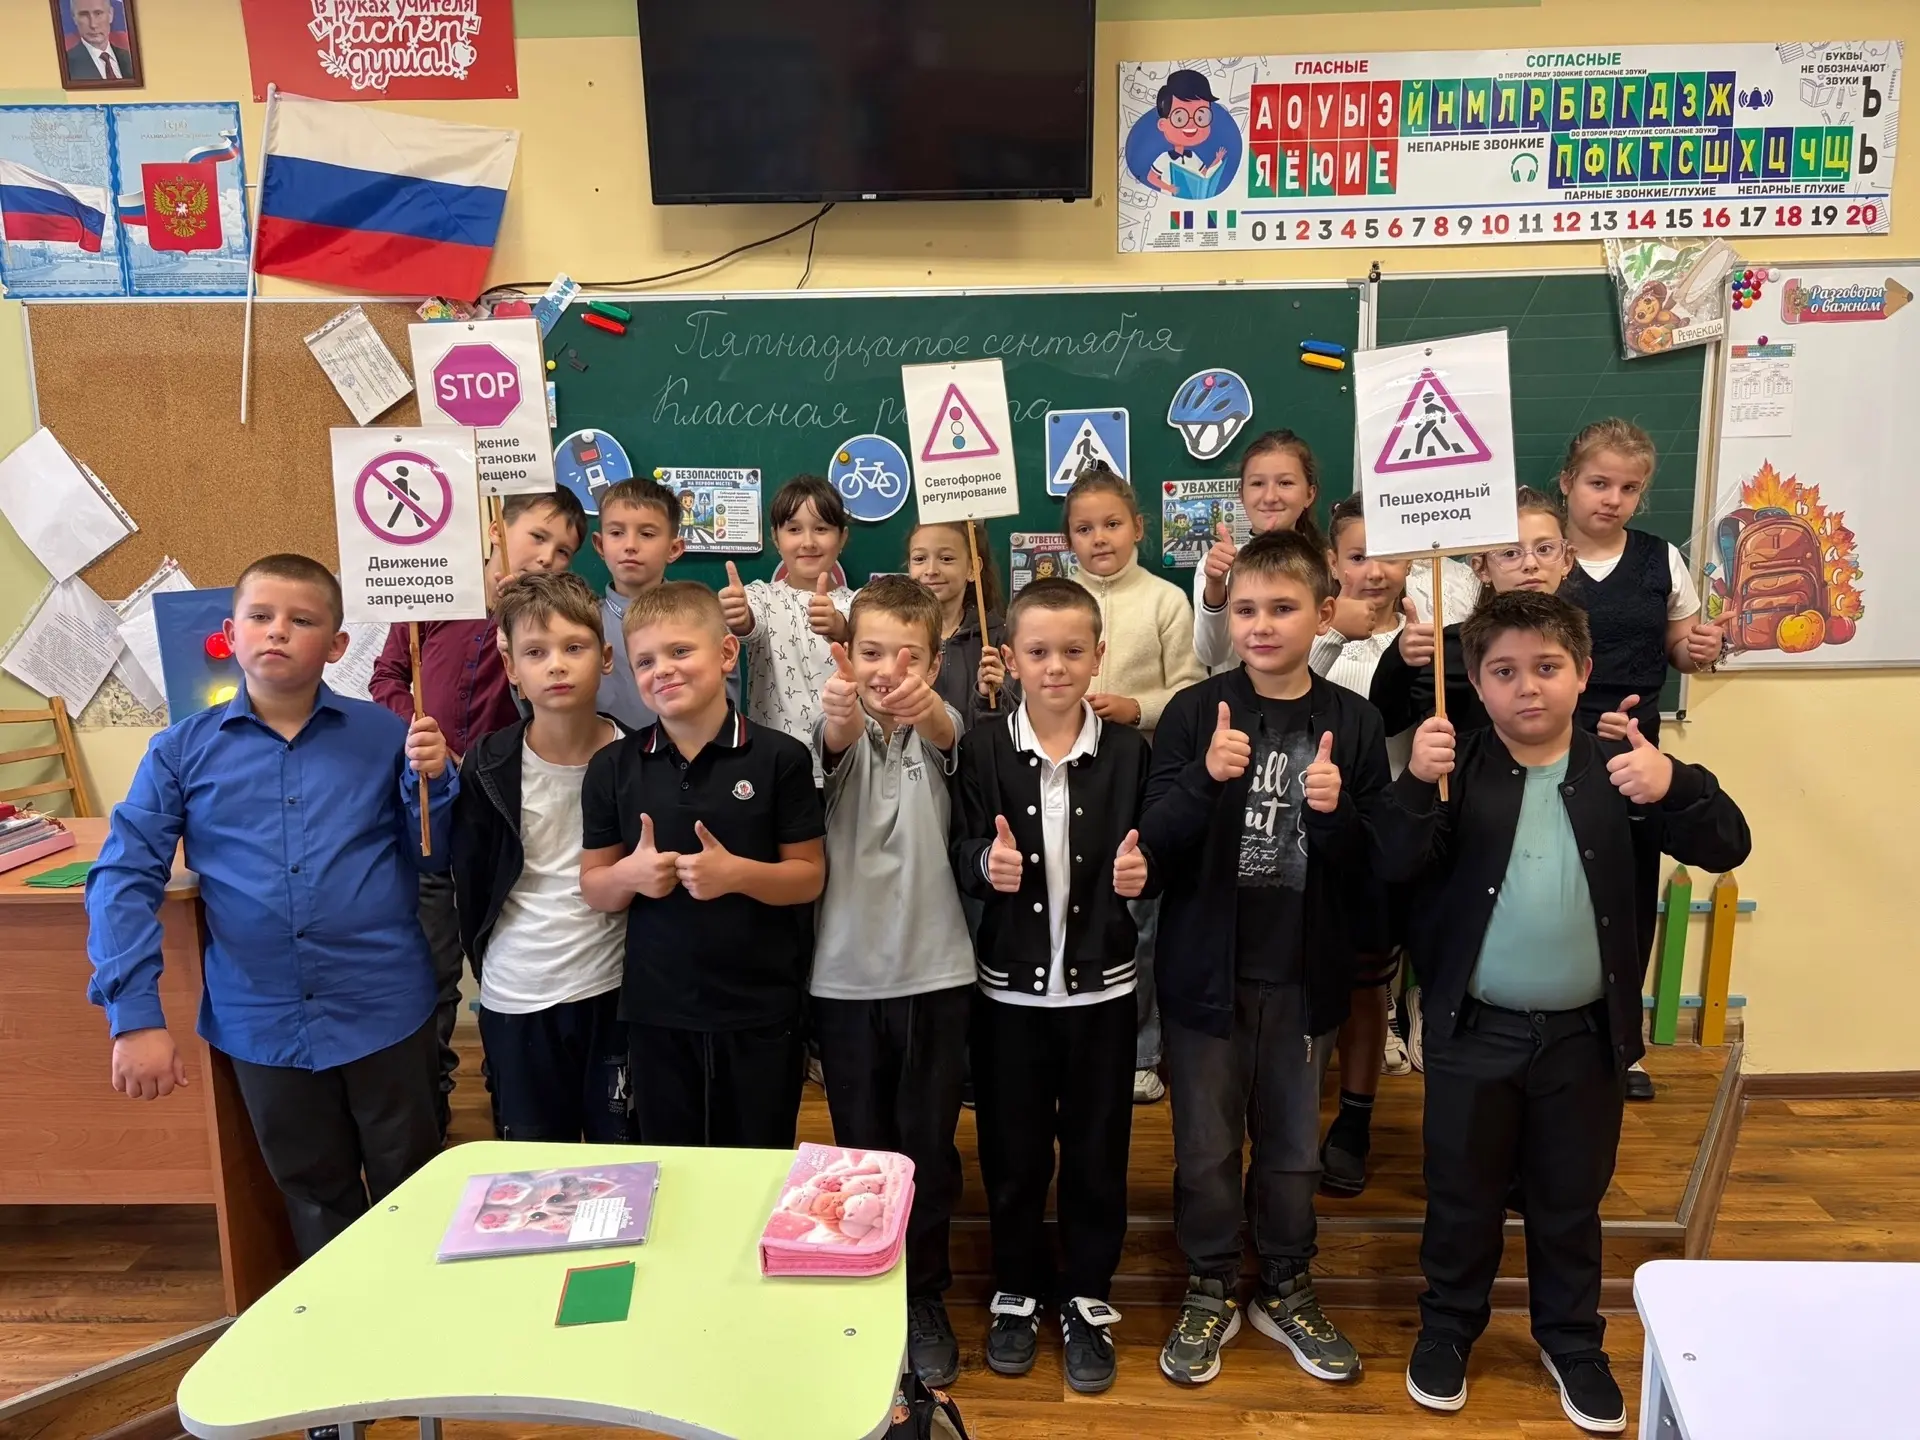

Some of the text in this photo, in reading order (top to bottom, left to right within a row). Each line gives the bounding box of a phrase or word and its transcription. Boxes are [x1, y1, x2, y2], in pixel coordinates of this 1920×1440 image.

[316, 0, 474, 21] В руках учителя
[330, 17, 466, 57] растёт
[349, 41, 452, 87] душа!
[1526, 53, 1621, 67] СОГЛАСНЫЕ
[1826, 52, 1862, 60] БУКВЫ
[1295, 60, 1368, 75] ГЛАСНЫЕ
[1801, 64, 1886, 74] НЕ ОБОЗНАЧАЮТ
[1826, 76, 1859, 85] ЗВУКИ
[1862, 76, 1882, 117] Ъ
[1256, 81, 1732, 130] А О У Ы Э Й Н М Л Р Б В Г Д З Ж
[1408, 138, 1544, 152] НЕПАРНЫЕ ЗВОНКИЕ
[1858, 133, 1878, 174] Ь
[1255, 136, 1848, 189] Я Ё Ю И Е П Ф К Т С Ш Х Ц Ч Щ
[1565, 187, 1716, 200] ПАРНЫЕ ЗВОНКИЕ/ГЛУХИЕ
[1738, 185, 1845, 194] НЕПАРНЫЕ ГЛУХИЕ
[1252, 221, 1266, 241] 0
[1276, 221, 1287, 240] 1
[1296, 220, 1310, 240] 2
[1318, 220, 1332, 240] 3
[1341, 219, 1356, 238] 4
[1365, 219, 1379, 238] 5
[1388, 218, 1403, 238] 6
[1413, 217, 1425, 237] 7
[1434, 217, 1448, 236] 8
[1458, 216, 1472, 235] 9
[1482, 214, 1509, 234] 10
[1519, 213, 1543, 233] 11
[1553, 212, 1581, 232] 12
[1590, 210, 1617, 230] 13
[1627, 210, 1656, 229] 14
[1666, 209, 1693, 228] 15
[1702, 208, 1730, 227] 16
[1740, 207, 1766, 227] 17
[1775, 206, 1802, 226] 18
[1811, 206, 1838, 225] 19
[1846, 204, 1877, 225] 20
[1811, 284, 1882, 301] Разговоры
[1811, 300, 1880, 313] о важном
[674, 310, 1186, 381] Пятнадцатое сентября
[440, 372, 515, 400] STOP
[653, 375, 856, 428] Классная
[477, 438, 519, 448] жение
[478, 453, 536, 464] тановки
[479, 470, 526, 481] ещено
[676, 470, 744, 480] БЕЗОПАСНОСТЬ
[925, 471, 1001, 488] Светофорное
[922, 484, 1007, 504] регулирование
[1182, 481, 1240, 493] УВАЖЕНИ
[1380, 483, 1490, 507] Пешеходный
[1402, 506, 1470, 525] переход
[1029, 536, 1066, 544] ОТВЕТСТВ
[368, 556, 448, 571] Движение
[365, 574, 454, 588] пешеходов
[367, 592, 454, 608] запрещено
[1248, 751, 1291, 797] ill
[1245, 798, 1291, 836] ut
